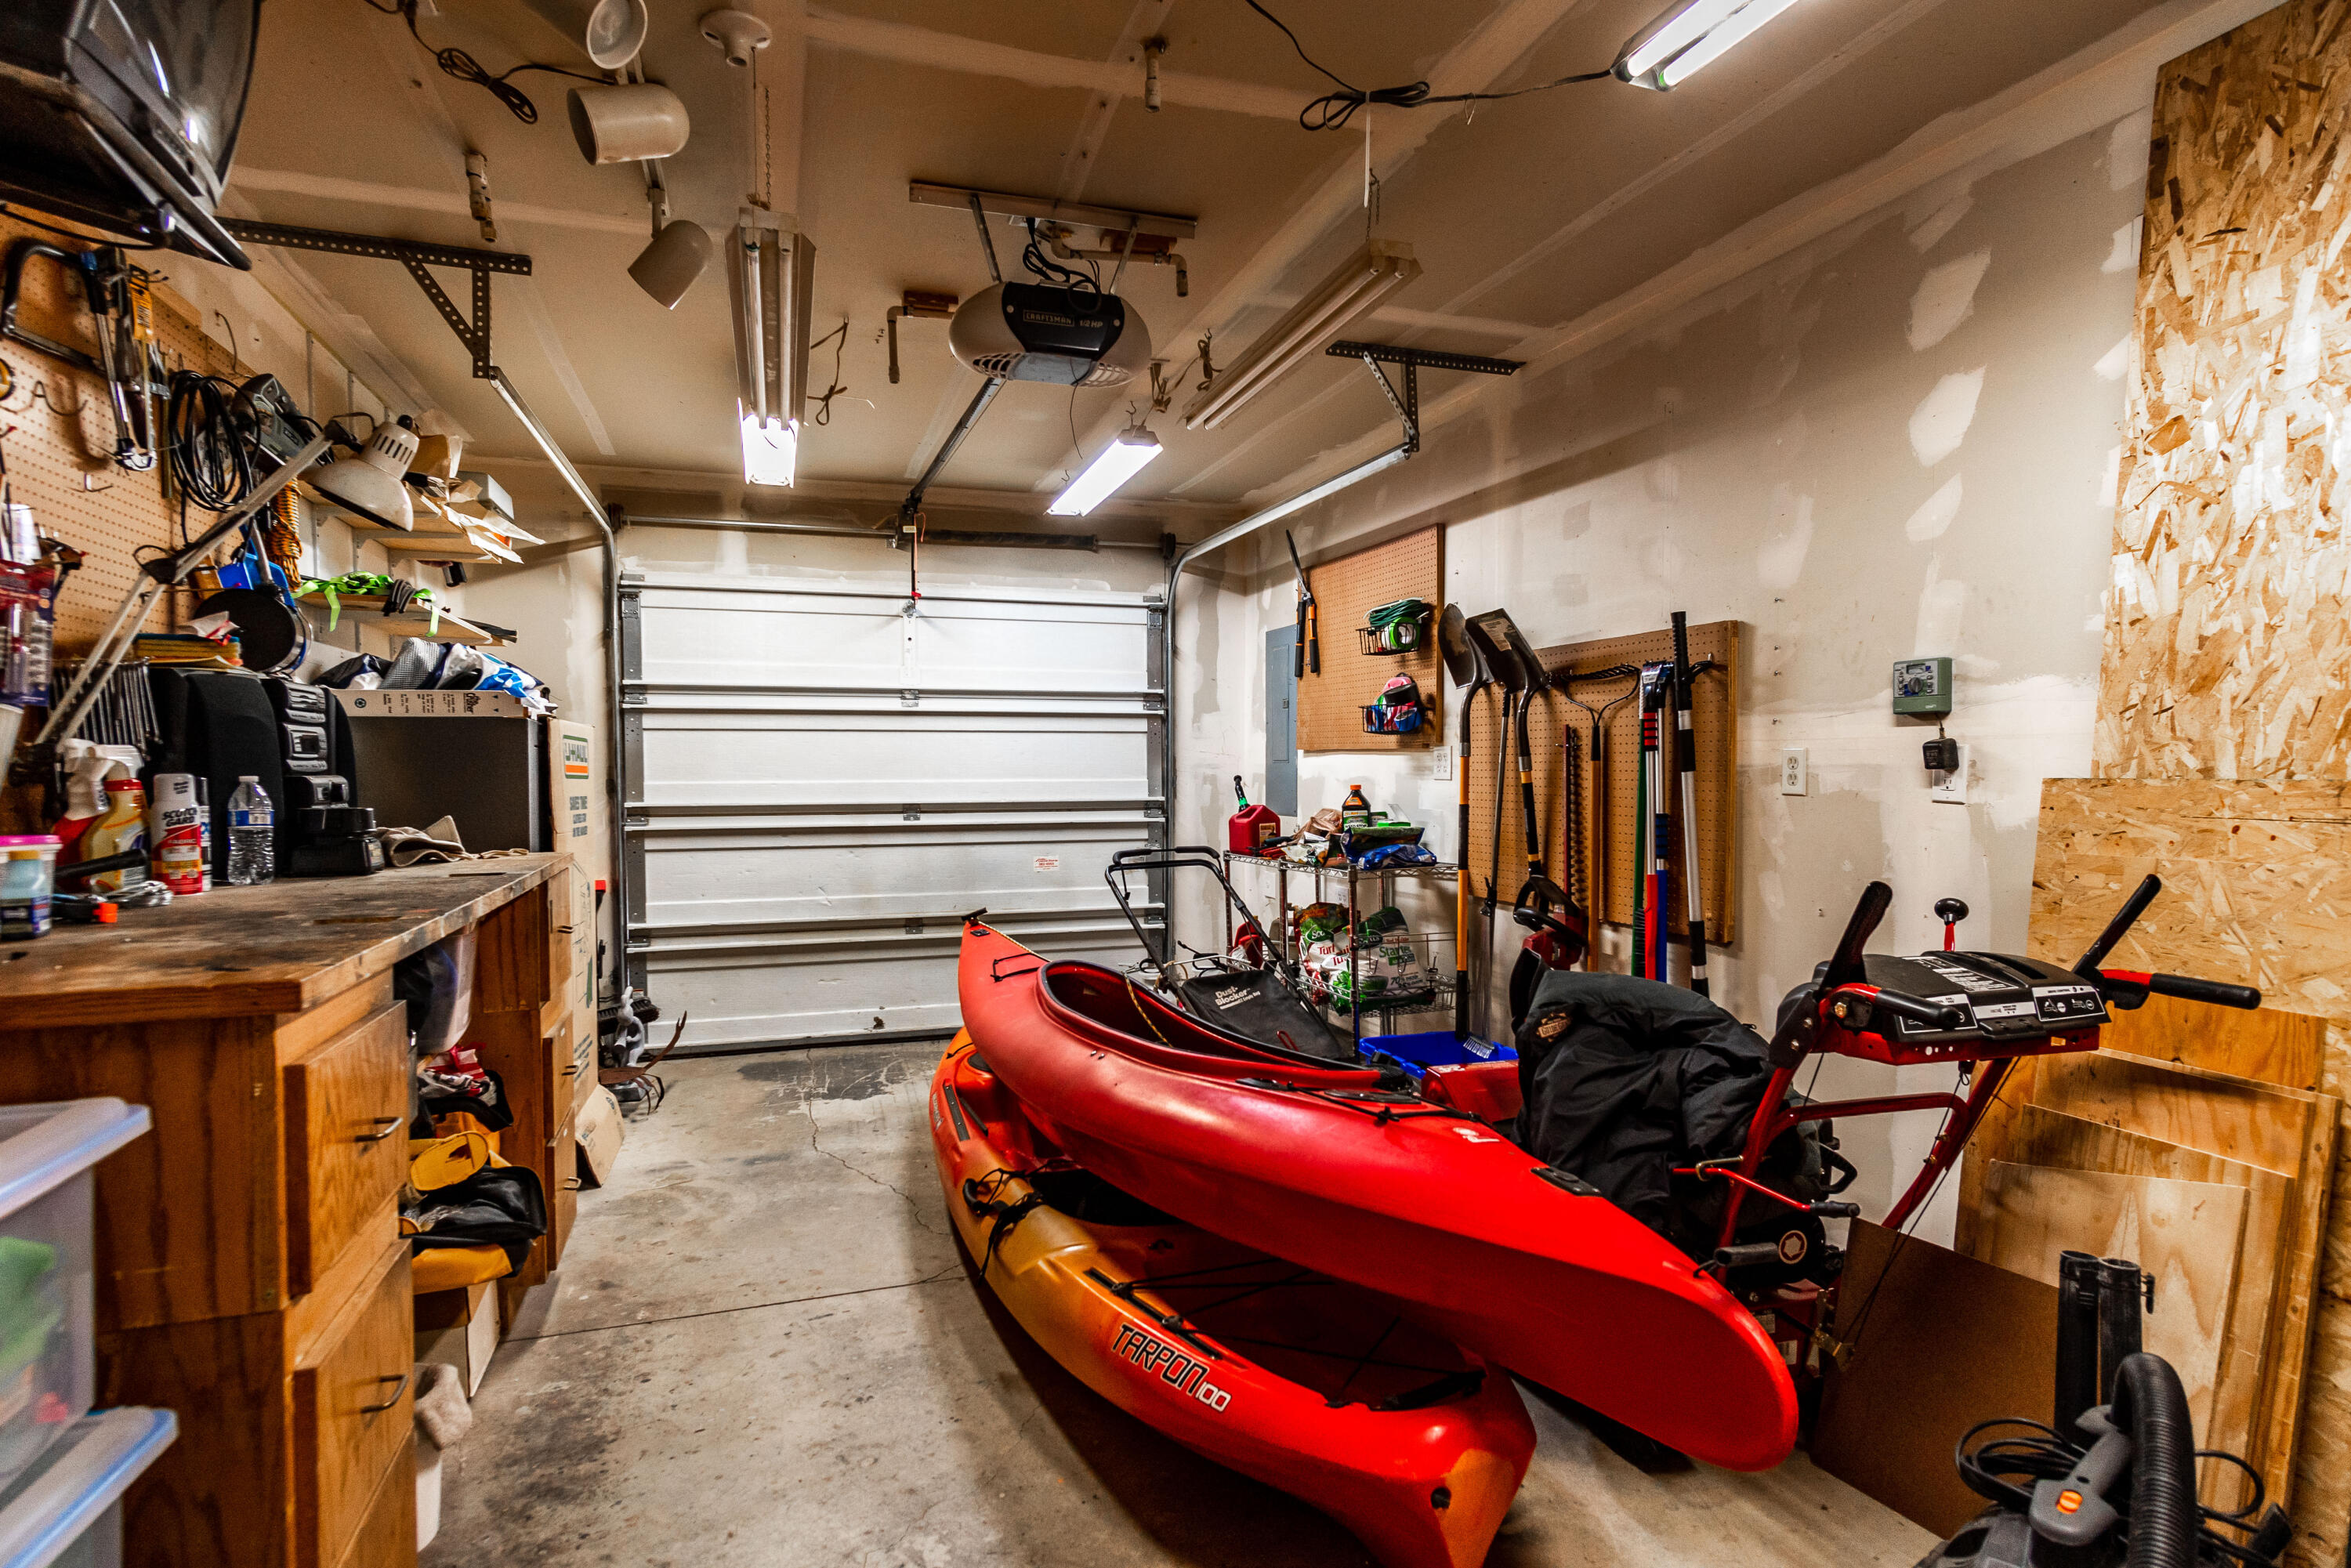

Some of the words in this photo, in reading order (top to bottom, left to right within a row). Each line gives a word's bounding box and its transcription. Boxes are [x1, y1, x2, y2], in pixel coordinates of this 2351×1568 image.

[1026, 313, 1072, 324] CRAFTSMAN
[564, 742, 588, 762] U-HAUL
[1215, 986, 1238, 998] Dust-
[1111, 1322, 1210, 1396] TARPON
[1195, 1382, 1232, 1411] 100
